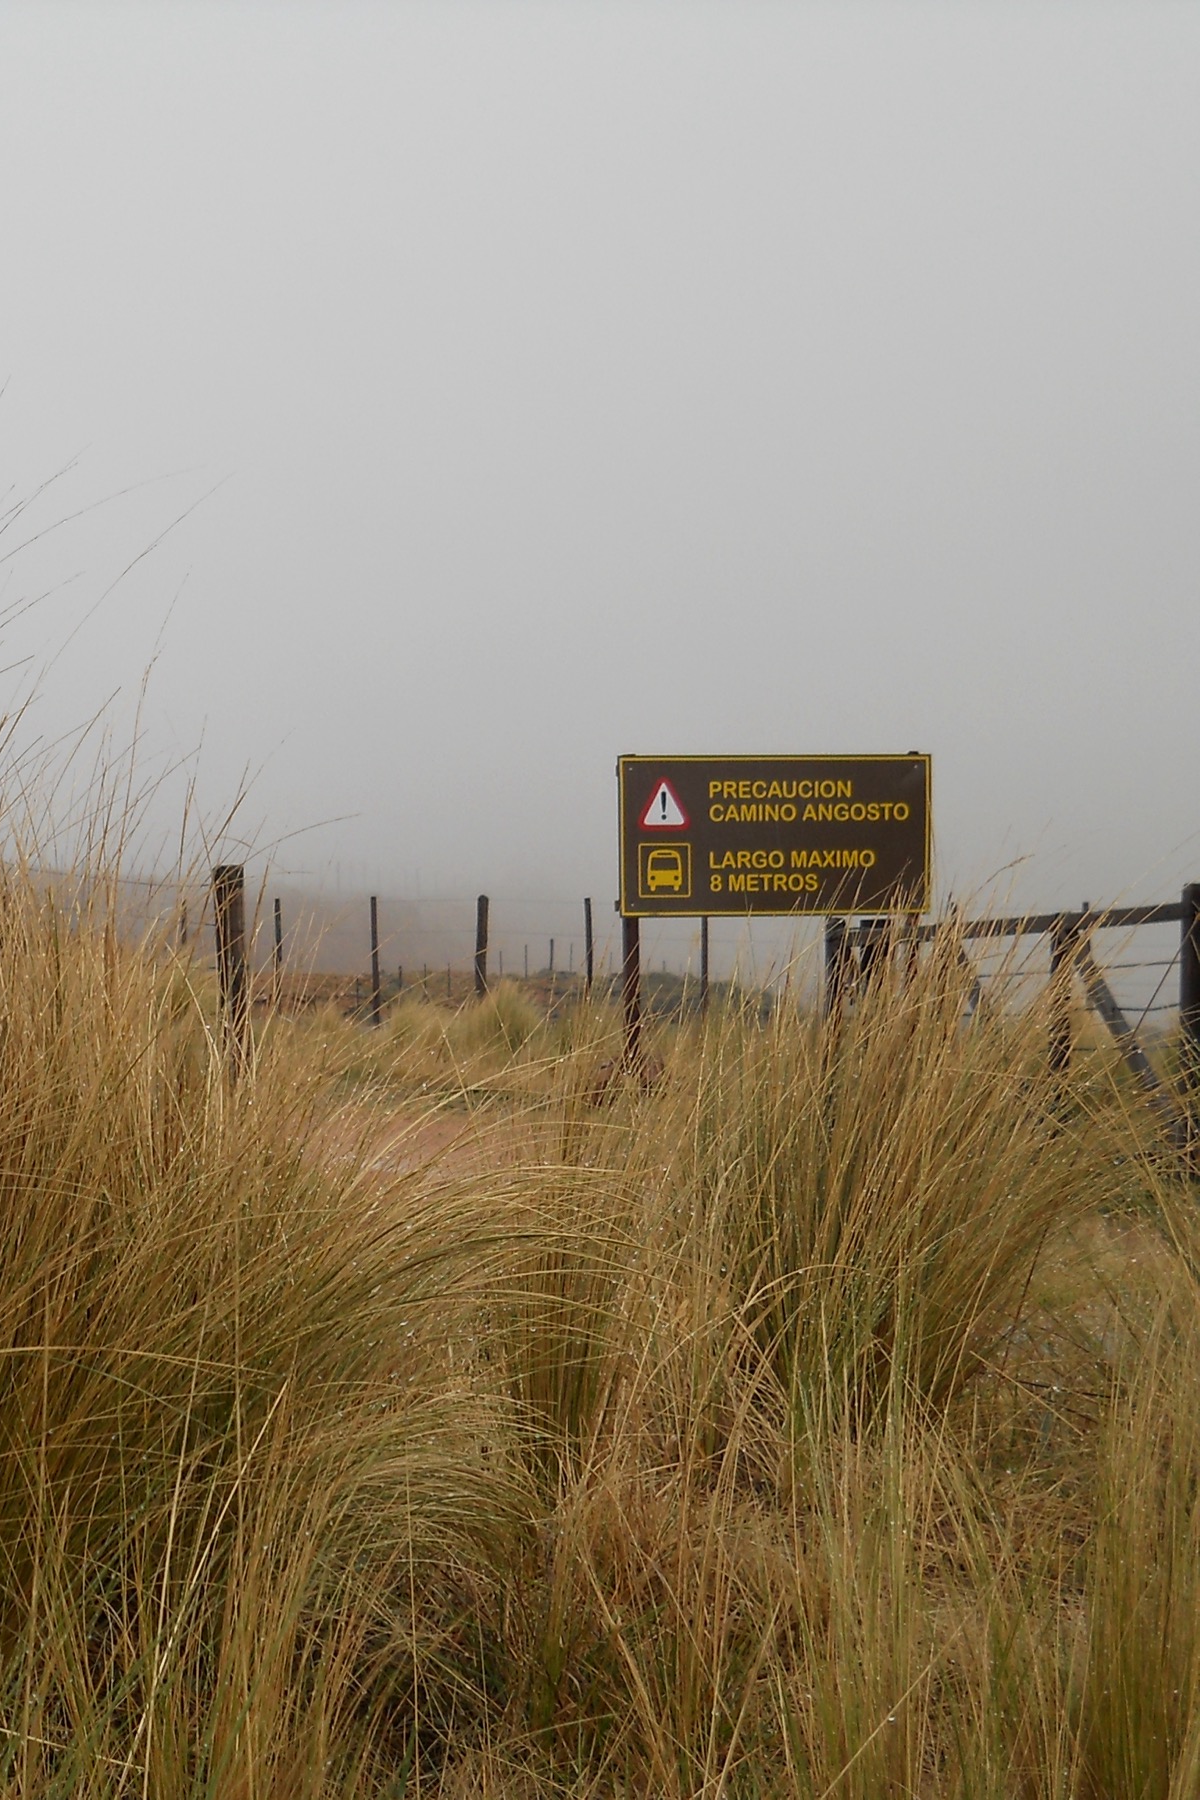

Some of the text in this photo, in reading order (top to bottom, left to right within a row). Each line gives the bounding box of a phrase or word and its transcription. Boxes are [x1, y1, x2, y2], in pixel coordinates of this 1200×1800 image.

[709, 780, 852, 798] PRECAUCION
[709, 802, 910, 822] CAMINO ANGOSTO
[710, 849, 876, 869] LARGO MAXIMO
[710, 873, 819, 892] 8 METROS
